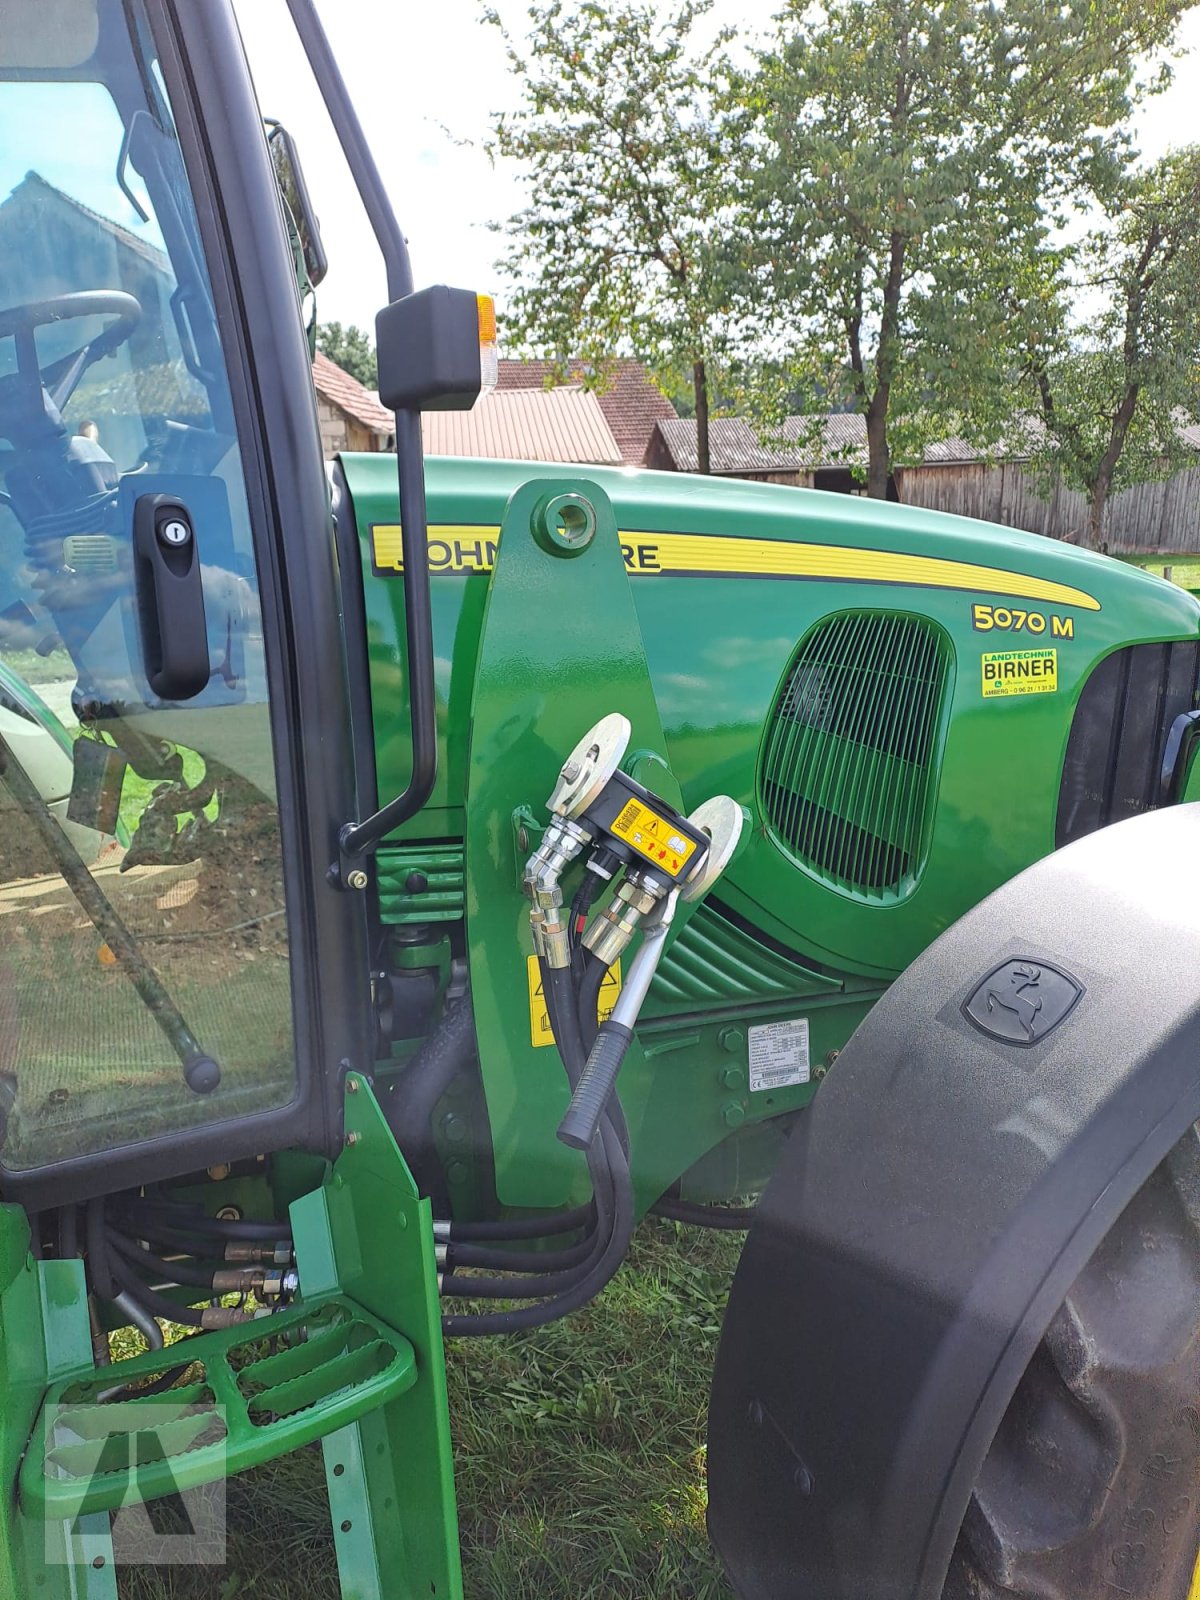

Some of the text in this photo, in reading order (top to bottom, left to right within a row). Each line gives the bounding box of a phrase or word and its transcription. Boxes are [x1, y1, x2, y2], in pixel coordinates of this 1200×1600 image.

[972, 604, 1074, 640] 5070 M
[984, 650, 1054, 662] LANDTECHNIK
[984, 659, 1055, 680] BIRNER
[984, 688, 1009, 696] AMBERG
